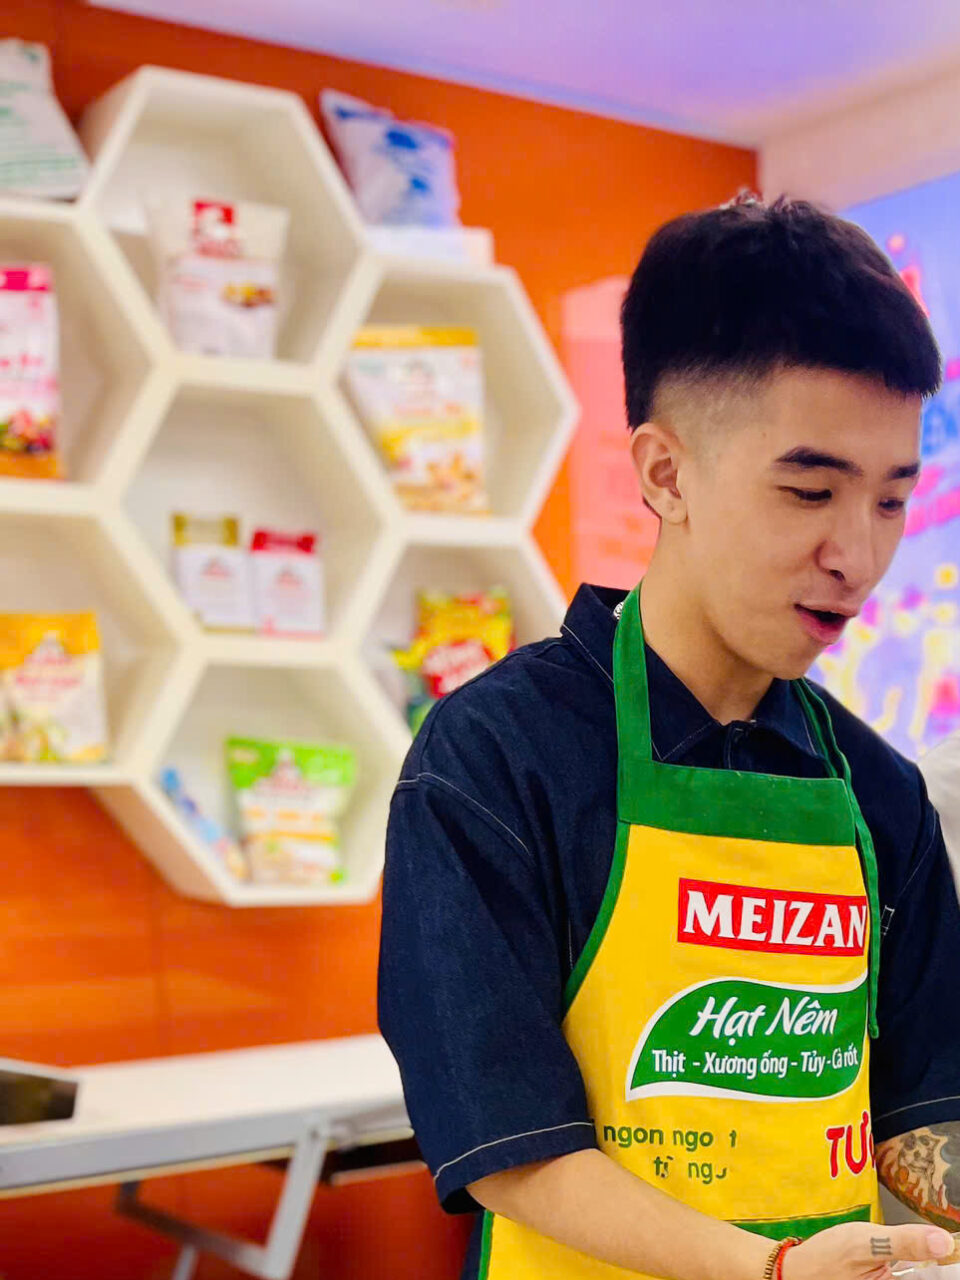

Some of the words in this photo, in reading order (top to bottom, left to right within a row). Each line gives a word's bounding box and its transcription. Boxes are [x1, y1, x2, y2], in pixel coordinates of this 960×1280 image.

[683, 890, 867, 948] MEIZAN
[689, 996, 766, 1046] Hạt
[765, 996, 838, 1036] Nêm
[652, 1050, 686, 1078] Thịt
[703, 1052, 756, 1080] Xương
[760, 1050, 788, 1079] ống
[801, 1050, 826, 1077] Tủy
[603, 1125, 664, 1148] ngon
[826, 1110, 875, 1178] TƯ
